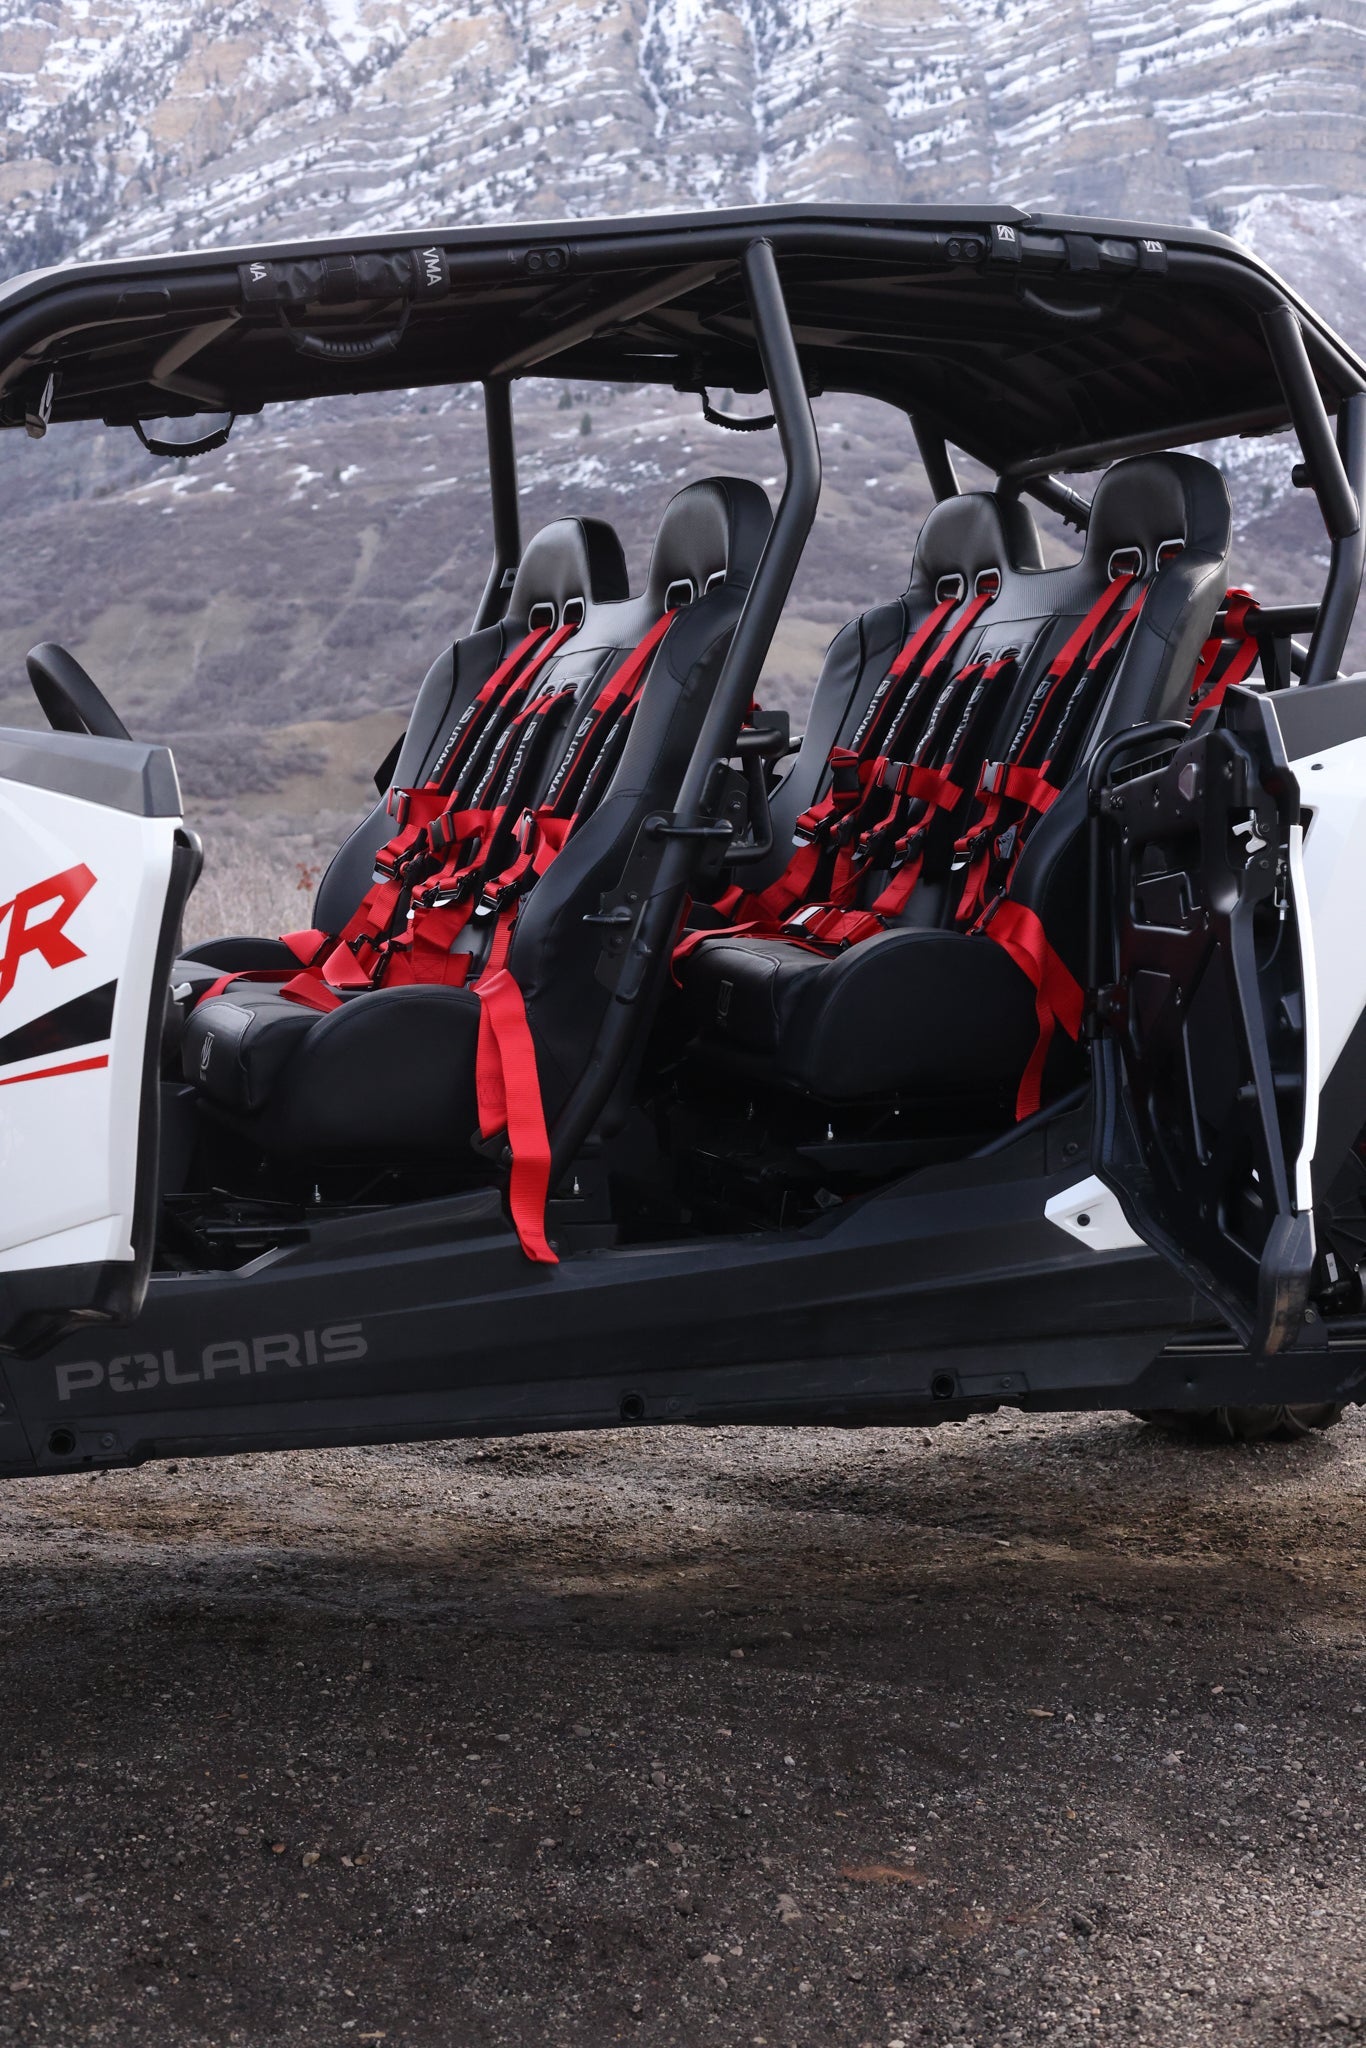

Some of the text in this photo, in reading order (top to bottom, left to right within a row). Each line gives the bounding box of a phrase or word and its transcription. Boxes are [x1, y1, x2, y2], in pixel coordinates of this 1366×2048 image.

[422, 246, 442, 287] VMA
[432, 726, 461, 772] UTVMA
[1009, 703, 1038, 752] UTVMA
[548, 740, 579, 794] UTVMA
[55, 1322, 368, 1401] POLARIS
